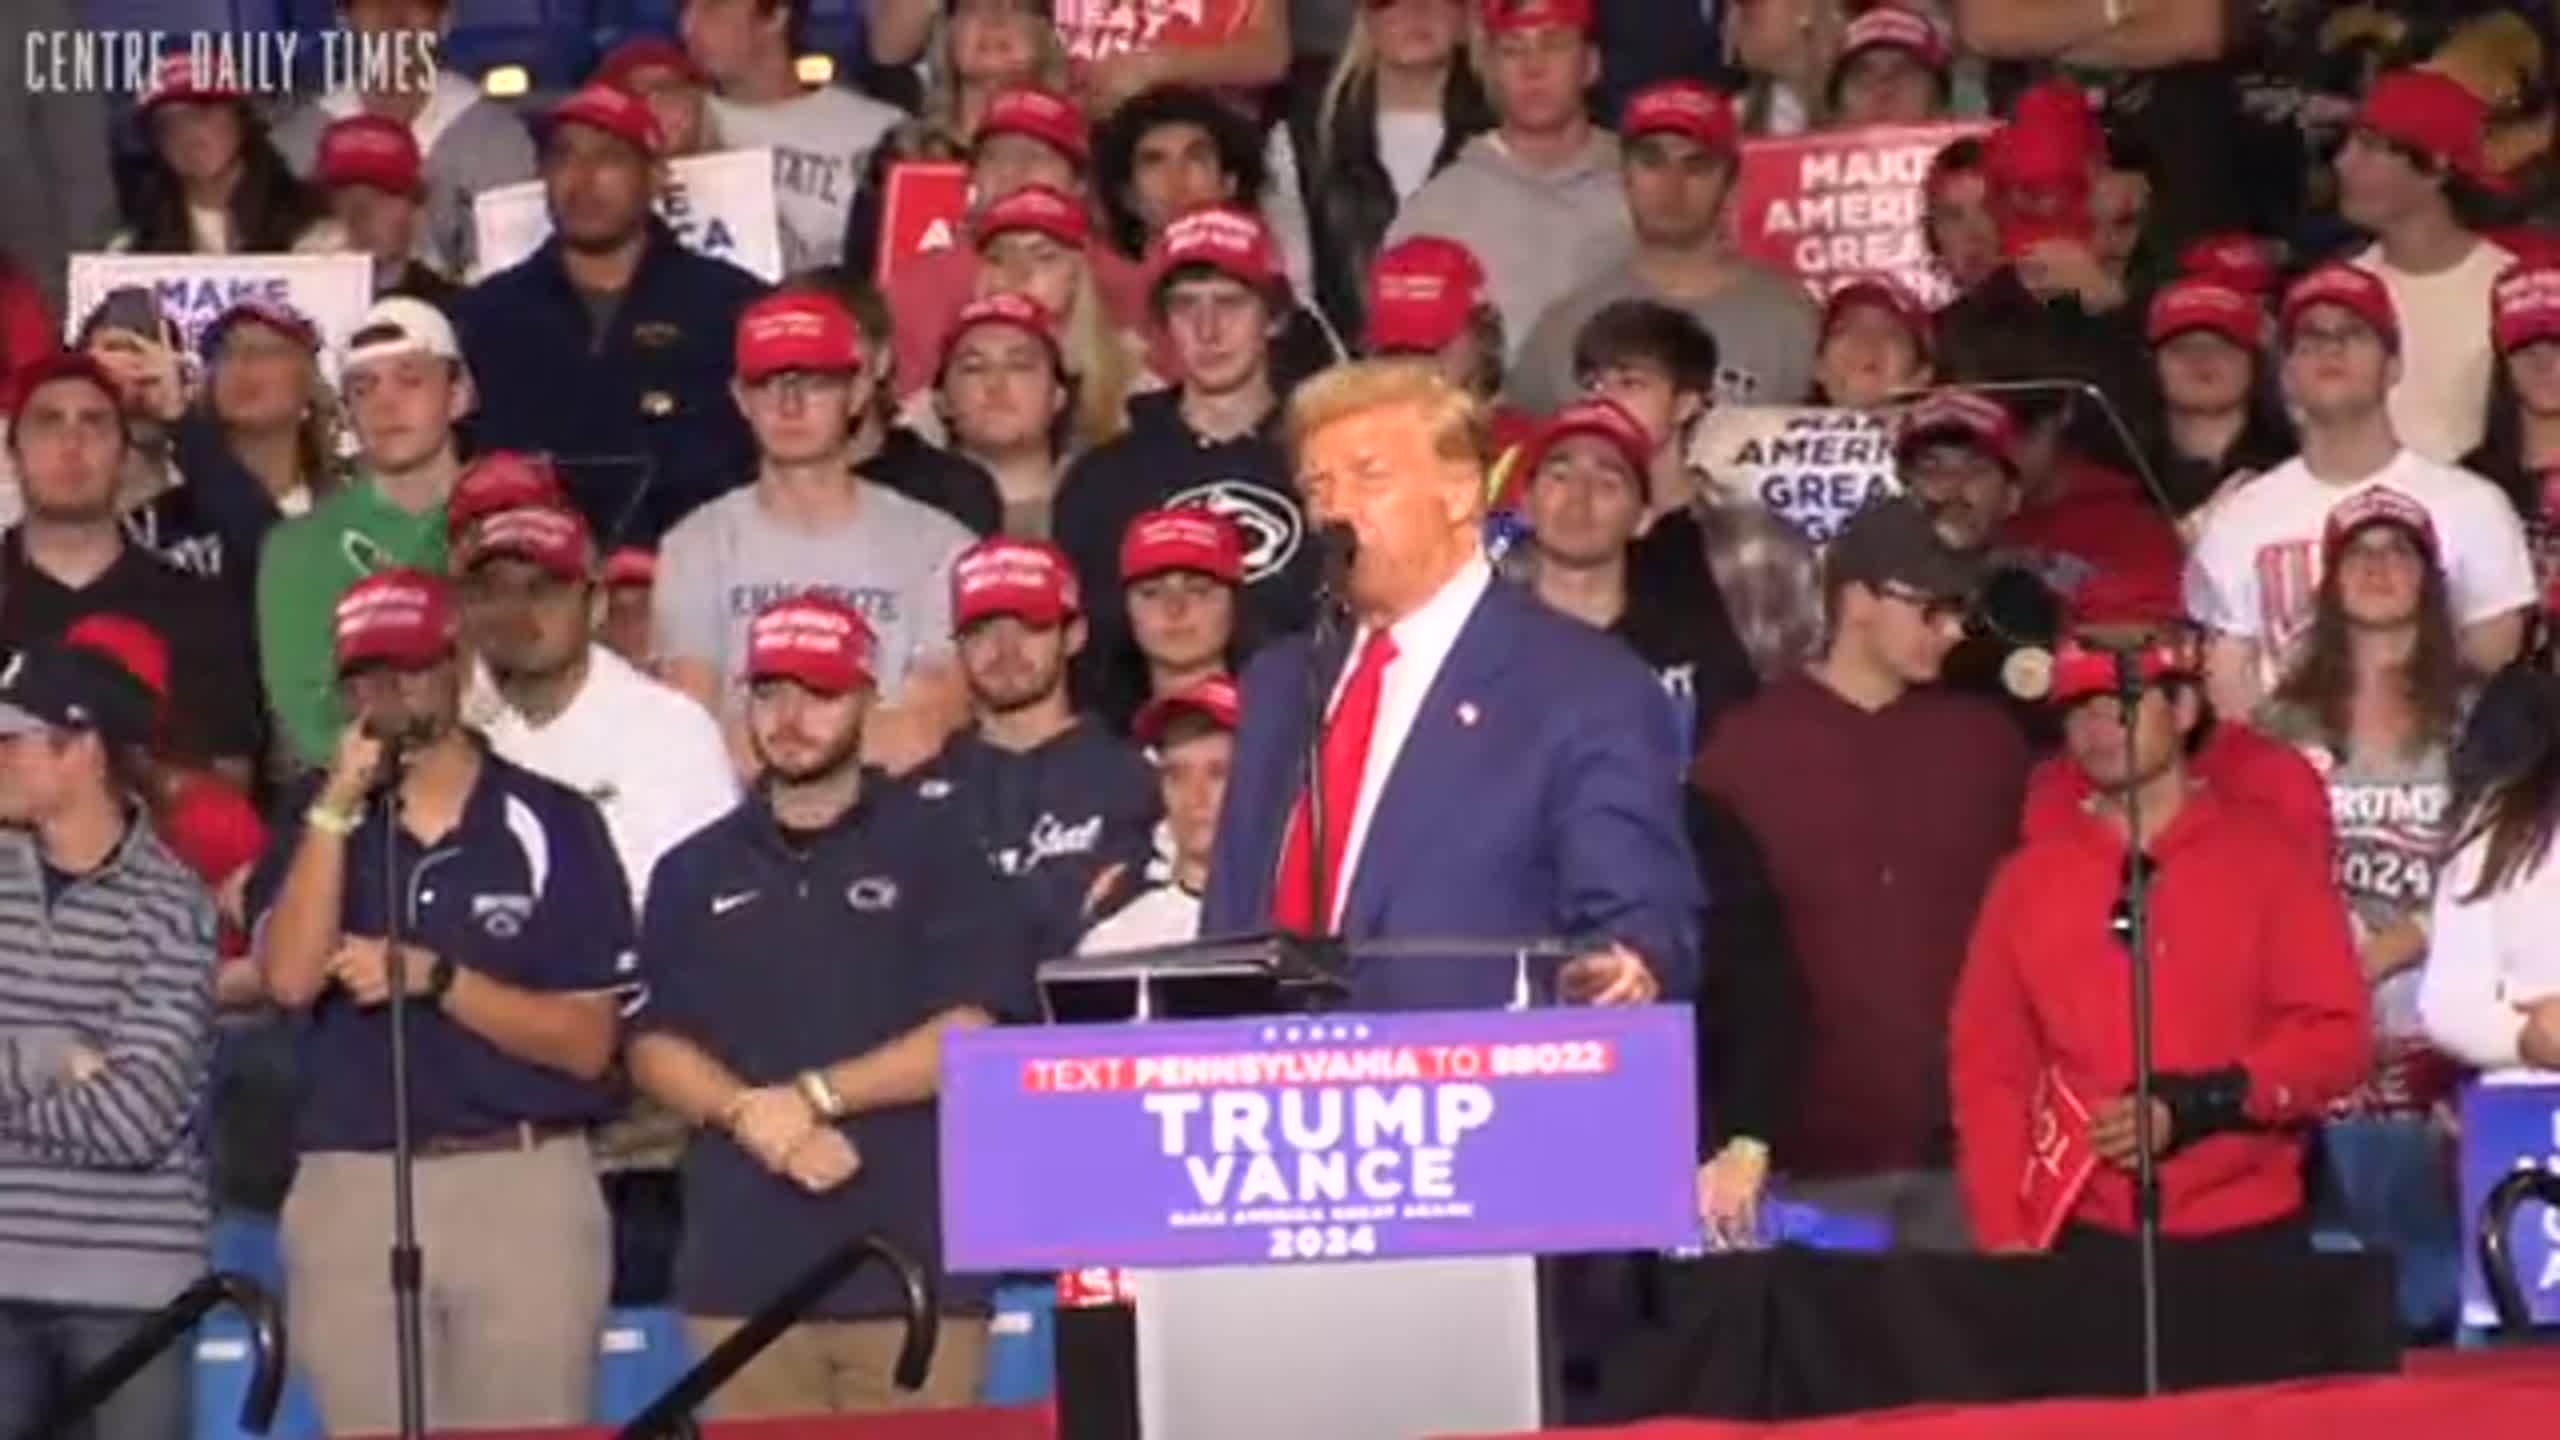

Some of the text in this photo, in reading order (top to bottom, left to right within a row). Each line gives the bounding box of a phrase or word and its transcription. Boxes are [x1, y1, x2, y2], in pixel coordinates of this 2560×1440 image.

[774, 148, 842, 205] TATE
[1762, 190, 1920, 236] AMERI
[1796, 232, 1926, 273] GREA
[1732, 437, 1889, 467] AMERI
[1760, 473, 1888, 510] GREA
[2330, 780, 2448, 824] RUMP
[2333, 850, 2432, 898] 024
[1031, 1057, 1126, 1092] TEXT
[1134, 1048, 1418, 1087] PENNSYLVANIA
[1434, 1046, 1478, 1077] TO
[1143, 1083, 1495, 1157] TRUMP
[1186, 1147, 1456, 1206] VANCE
[1268, 1225, 1377, 1259] 2024
